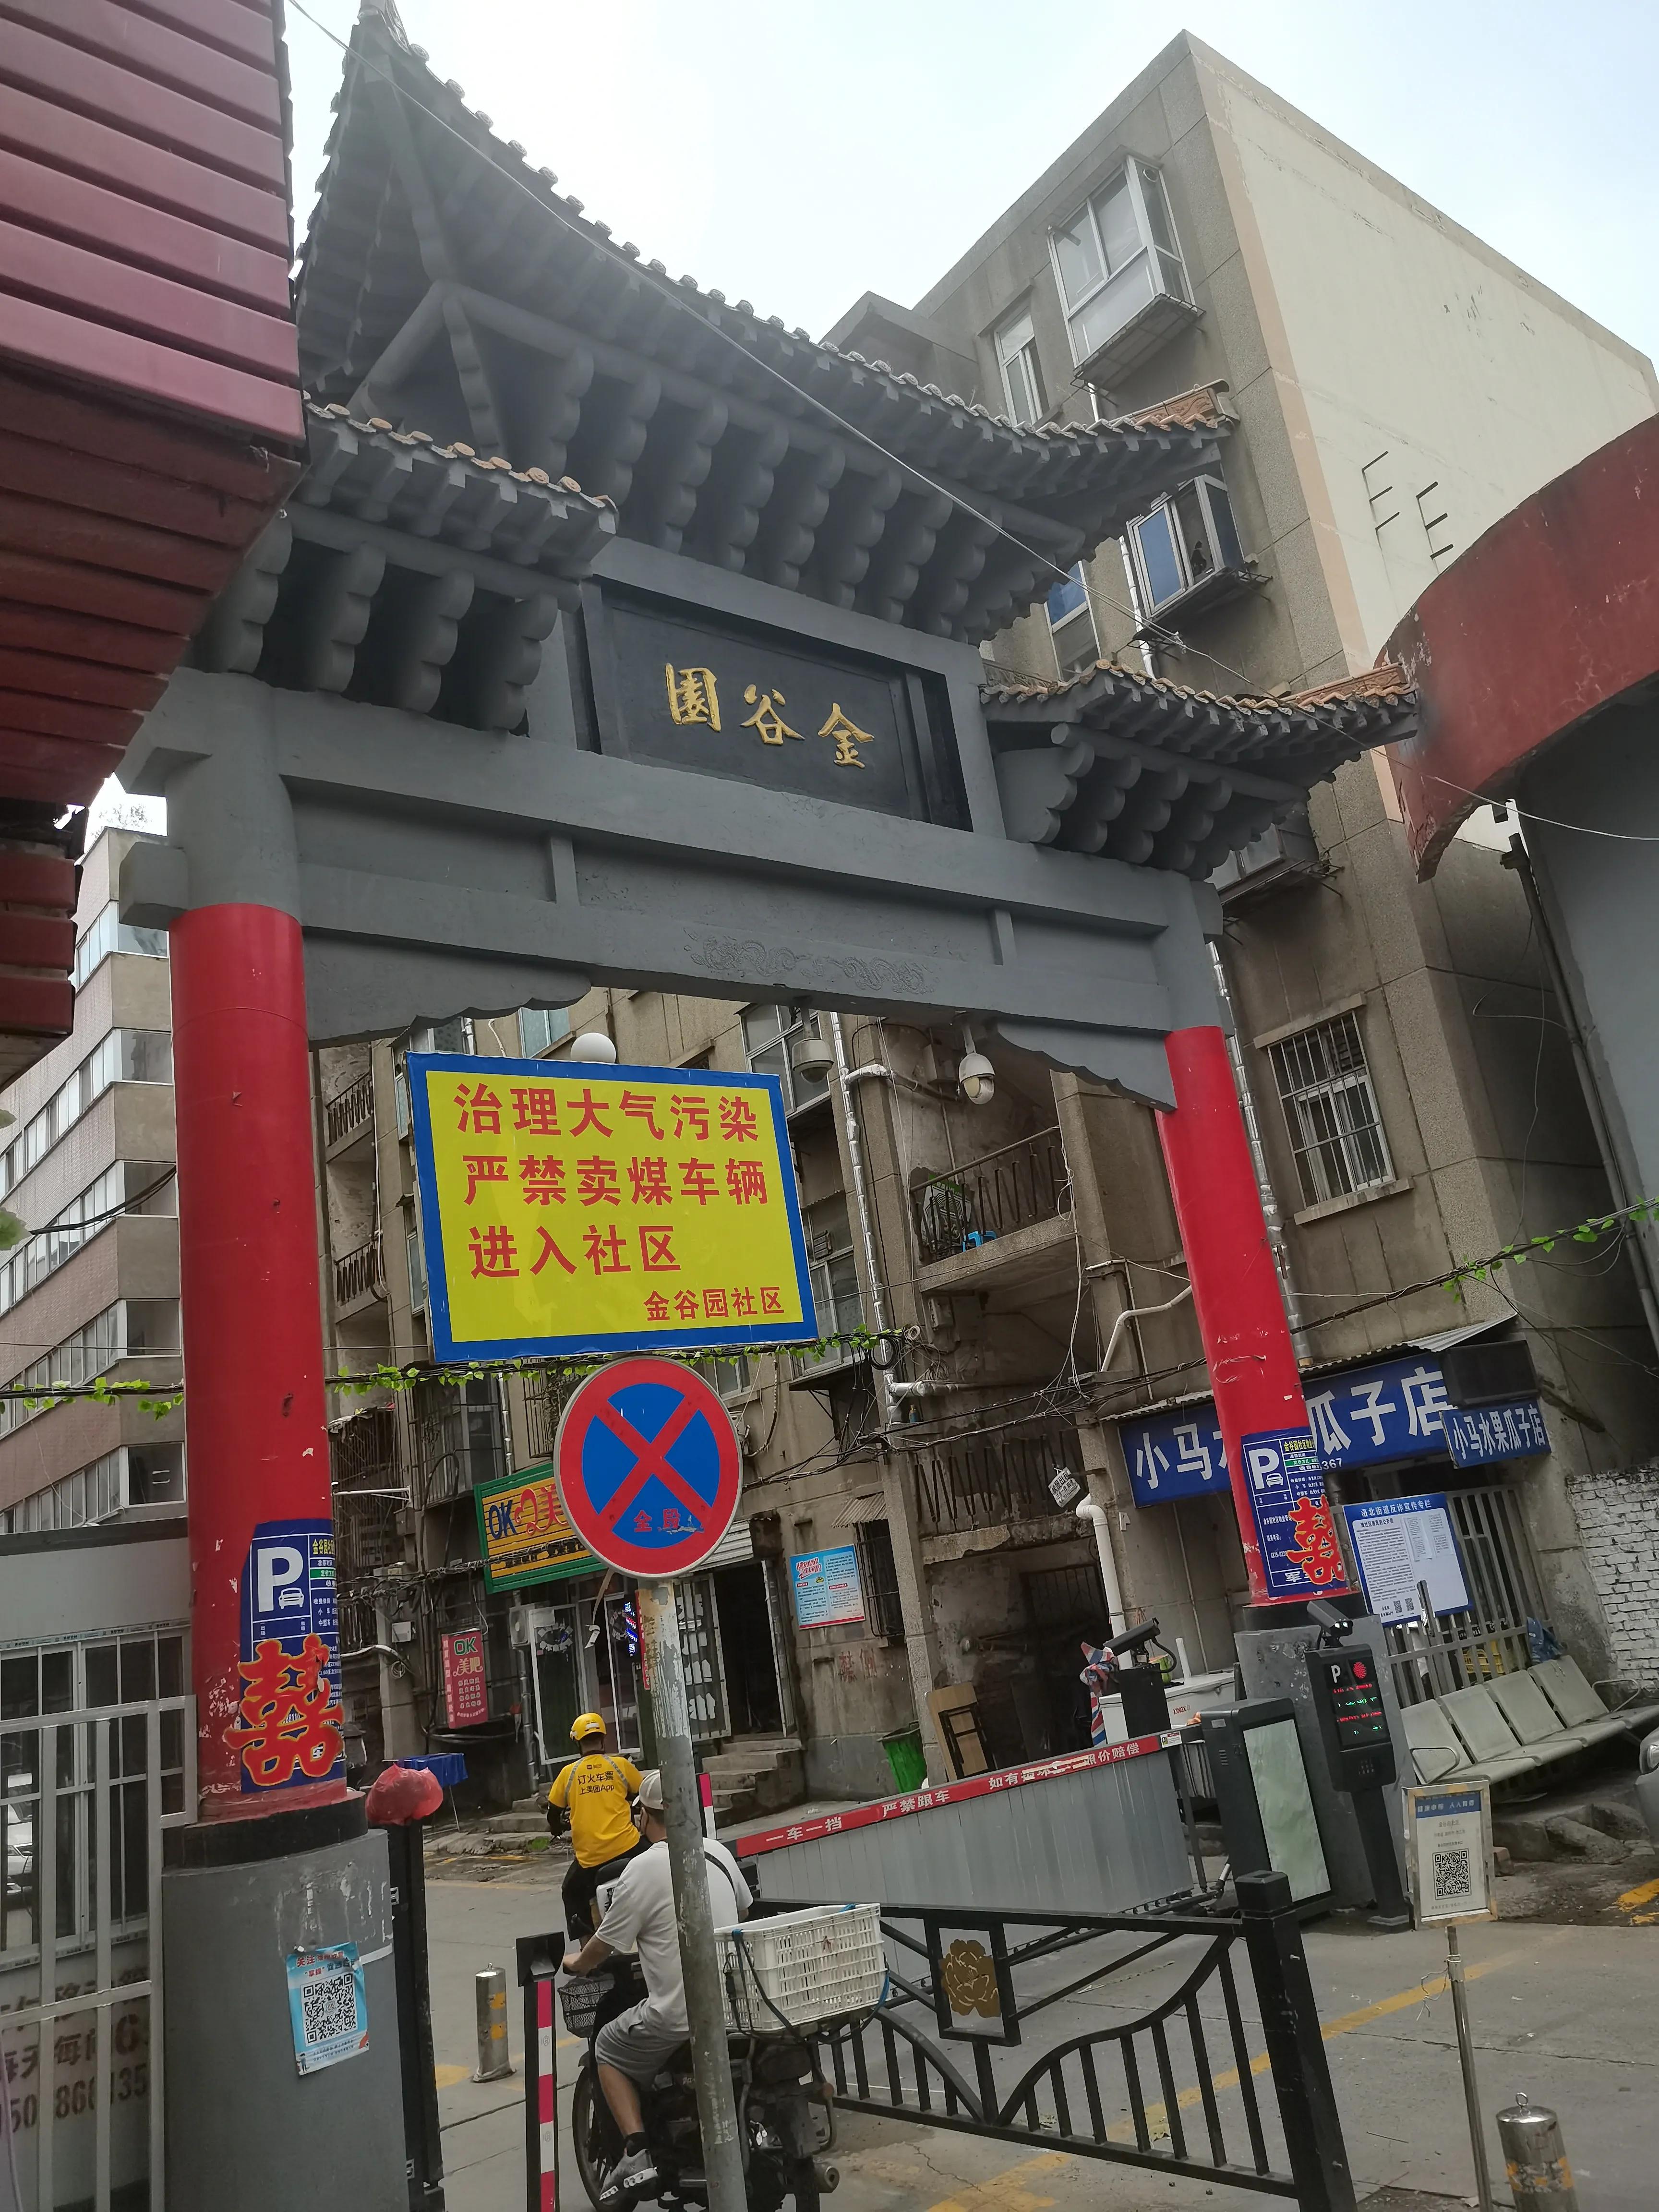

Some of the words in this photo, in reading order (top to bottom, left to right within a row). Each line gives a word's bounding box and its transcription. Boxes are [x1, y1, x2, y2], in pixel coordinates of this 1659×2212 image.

[454, 1083, 759, 1142] 治理大气污染
[462, 1155, 769, 1206] 严禁卖煤车辆
[469, 1225, 681, 1279] 进入社区
[644, 1287, 785, 1322] 金谷园社区
[1453, 1404, 1546, 1460] 小马水果瓜子店
[1248, 1448, 1279, 1489] P
[488, 1499, 517, 1540] OK
[257, 1546, 303, 1612] P
[454, 1636, 478, 1656] OK
[1331, 1665, 1341, 1683] P
[577, 1771, 614, 1785] 订火车票
[579, 1784, 614, 1795] 上美团App
[766, 1816, 842, 1842] 一车一挡
[882, 1790, 950, 1818] 严禁跟车
[297, 1955, 315, 1967] 关注
